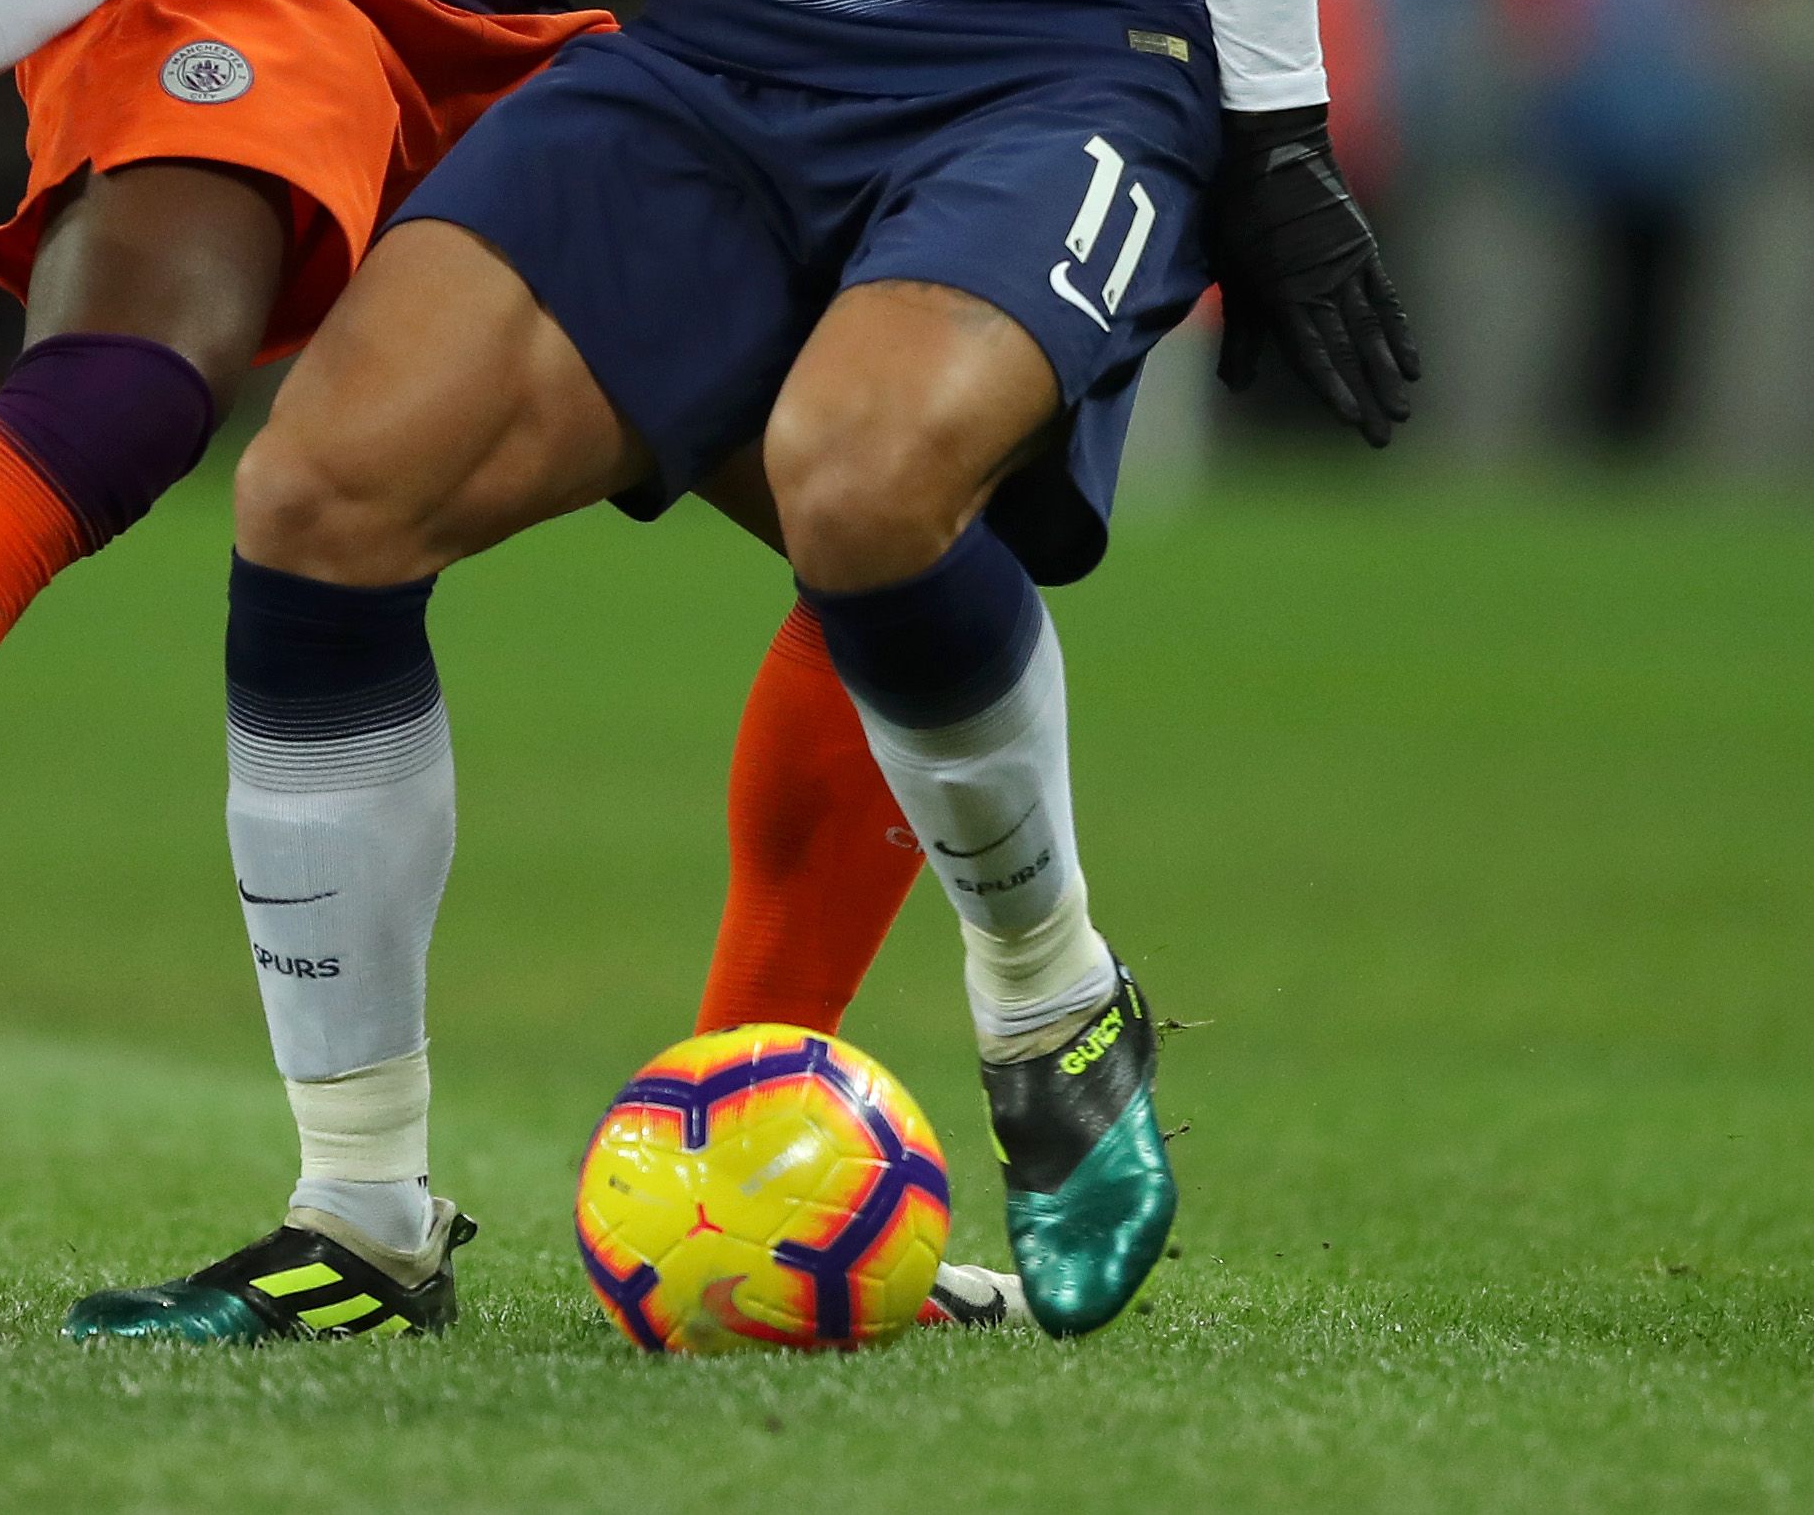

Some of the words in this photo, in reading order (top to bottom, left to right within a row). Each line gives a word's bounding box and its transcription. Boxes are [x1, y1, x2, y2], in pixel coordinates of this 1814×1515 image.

[1064, 133, 1158, 318] 11
[954, 848, 1051, 897] SPURS
[252, 943, 341, 980] SPURS
